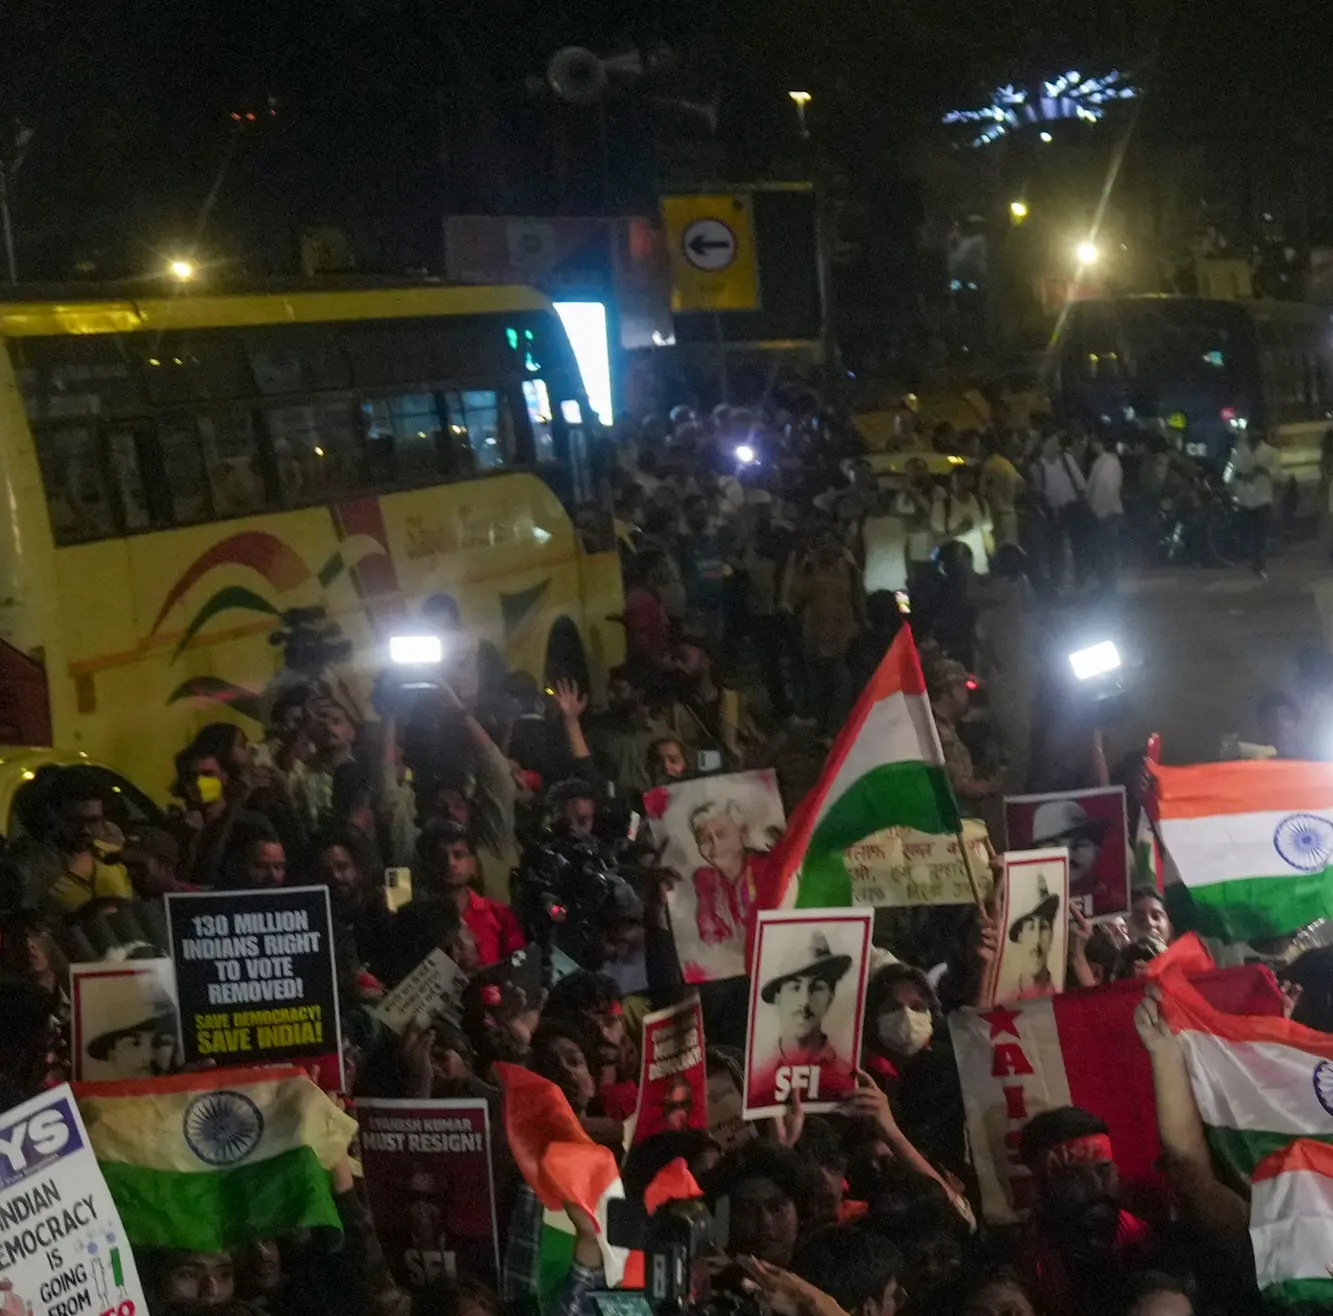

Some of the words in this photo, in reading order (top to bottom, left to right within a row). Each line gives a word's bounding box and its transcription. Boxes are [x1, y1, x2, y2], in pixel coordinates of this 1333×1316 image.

[1069, 893, 1094, 918] FI
[191, 914, 229, 937] 130
[233, 910, 309, 935] MILLION
[182, 936, 260, 960] INDIANS
[263, 931, 321, 955] RIGHT
[215, 960, 241, 982] TO
[245, 956, 294, 979] VOTE
[208, 977, 304, 1005] REMOVED!
[195, 1013, 230, 1029] SAVE
[233, 1005, 321, 1027] DEMOCRACY!
[197, 1028, 252, 1054] SAVE
[256, 1021, 323, 1050] INDIA!
[774, 1064, 820, 1102] SFI
[424, 1118, 472, 1131] KUMAR
[363, 1132, 407, 1151] MUST
[408, 1132, 483, 1152] RESIGN!
[0, 1194, 98, 1271] EMOCRACY
[46, 1248, 64, 1271] IS
[40, 1263, 88, 1305] GOING
